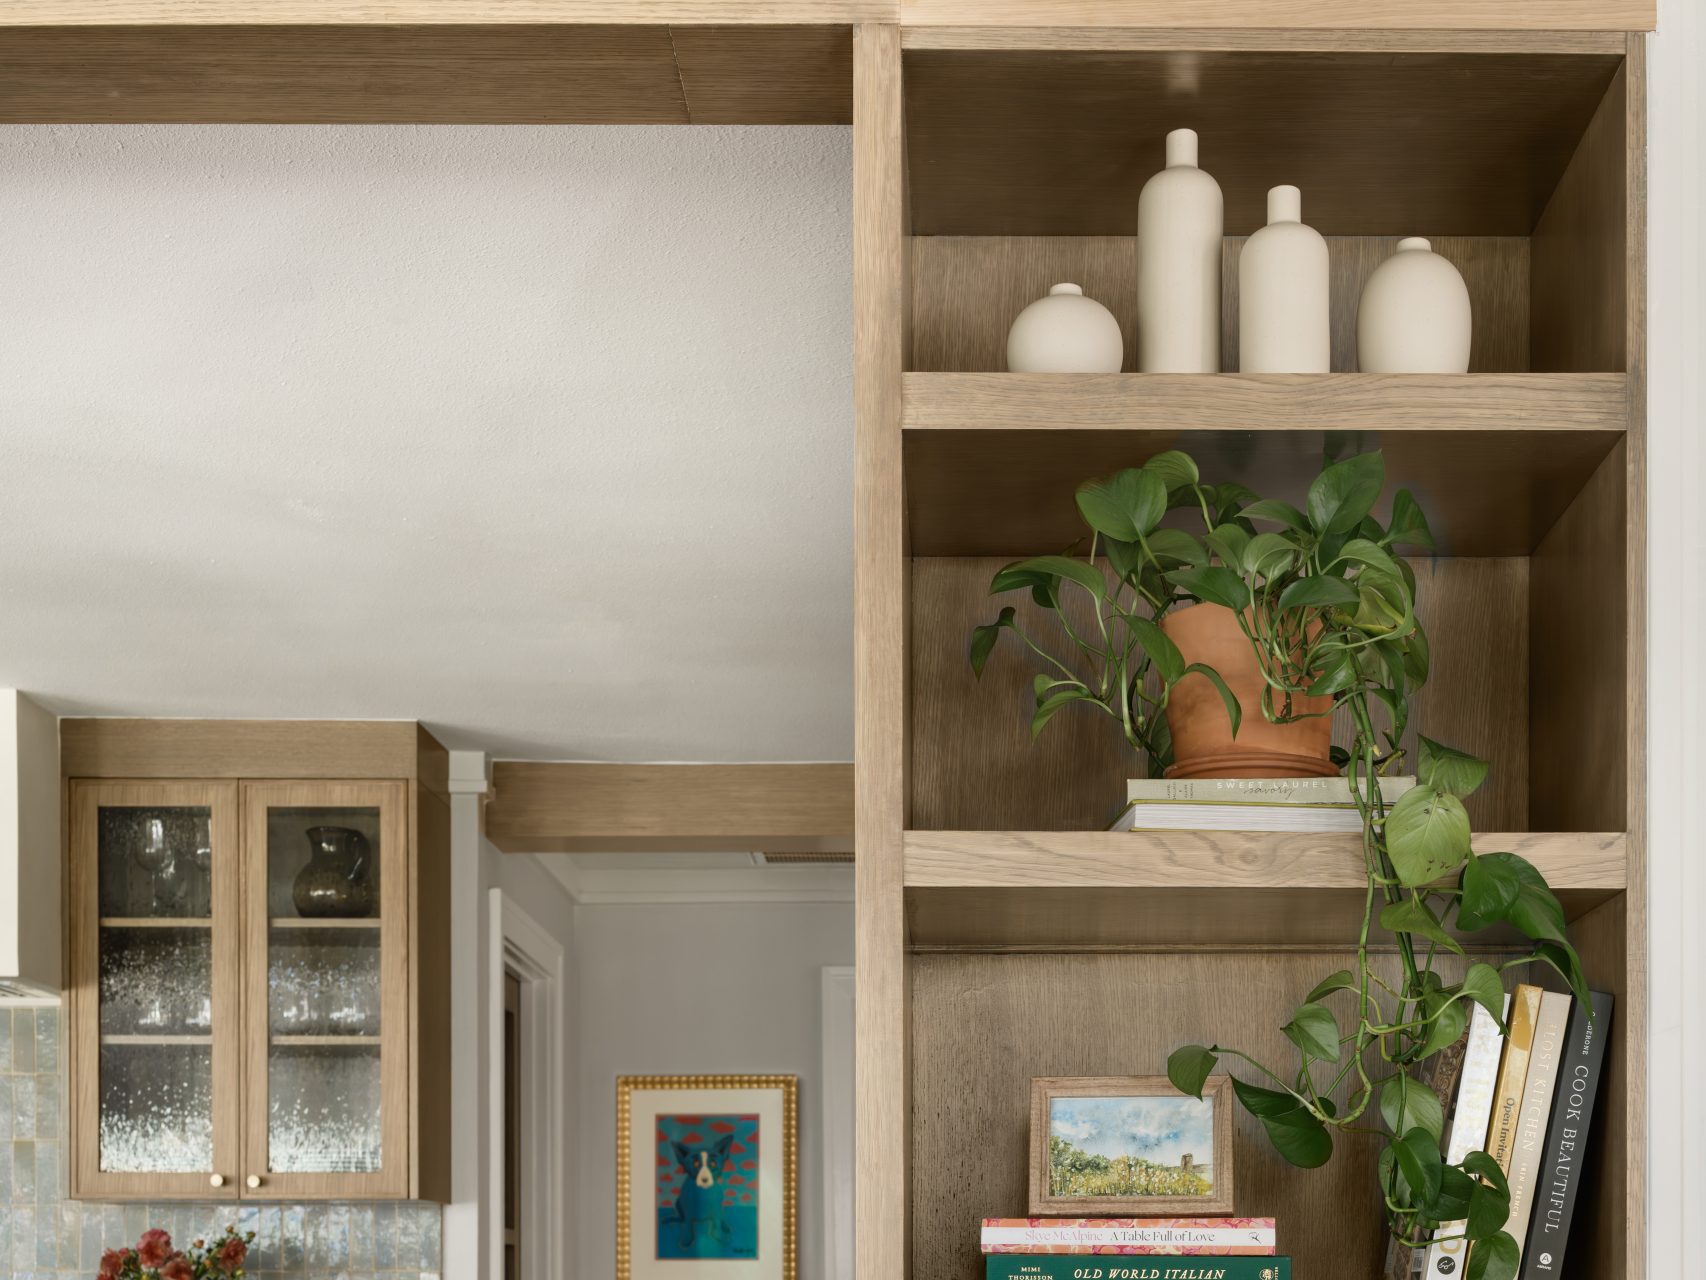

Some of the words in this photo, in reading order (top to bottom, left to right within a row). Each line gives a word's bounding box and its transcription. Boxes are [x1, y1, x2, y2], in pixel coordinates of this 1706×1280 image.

[1216, 781, 1264, 790] SWEET
[1273, 779, 1328, 788] LAUREL
[1243, 785, 1296, 800] savory
[1538, 1030, 1556, 1071] LOST
[1566, 1065, 1589, 1120] COOK
[1502, 1097, 1515, 1126] Open
[1522, 1078, 1548, 1152] KITCHEN
[1545, 1127, 1577, 1233] BEAUTIFUL
[1025, 1230, 1051, 1243] Skye
[1053, 1230, 1103, 1244] McAlpine
[1110, 1231, 1119, 1241] A
[1120, 1230, 1151, 1241] Table
[1153, 1230, 1173, 1241] Full
[1174, 1230, 1187, 1241] of
[1188, 1231, 1215, 1242] Love
[1073, 1268, 1103, 1280] OLD
[1108, 1268, 1160, 1280] WORLD
[1163, 1269, 1226, 1280] ITALIAN
